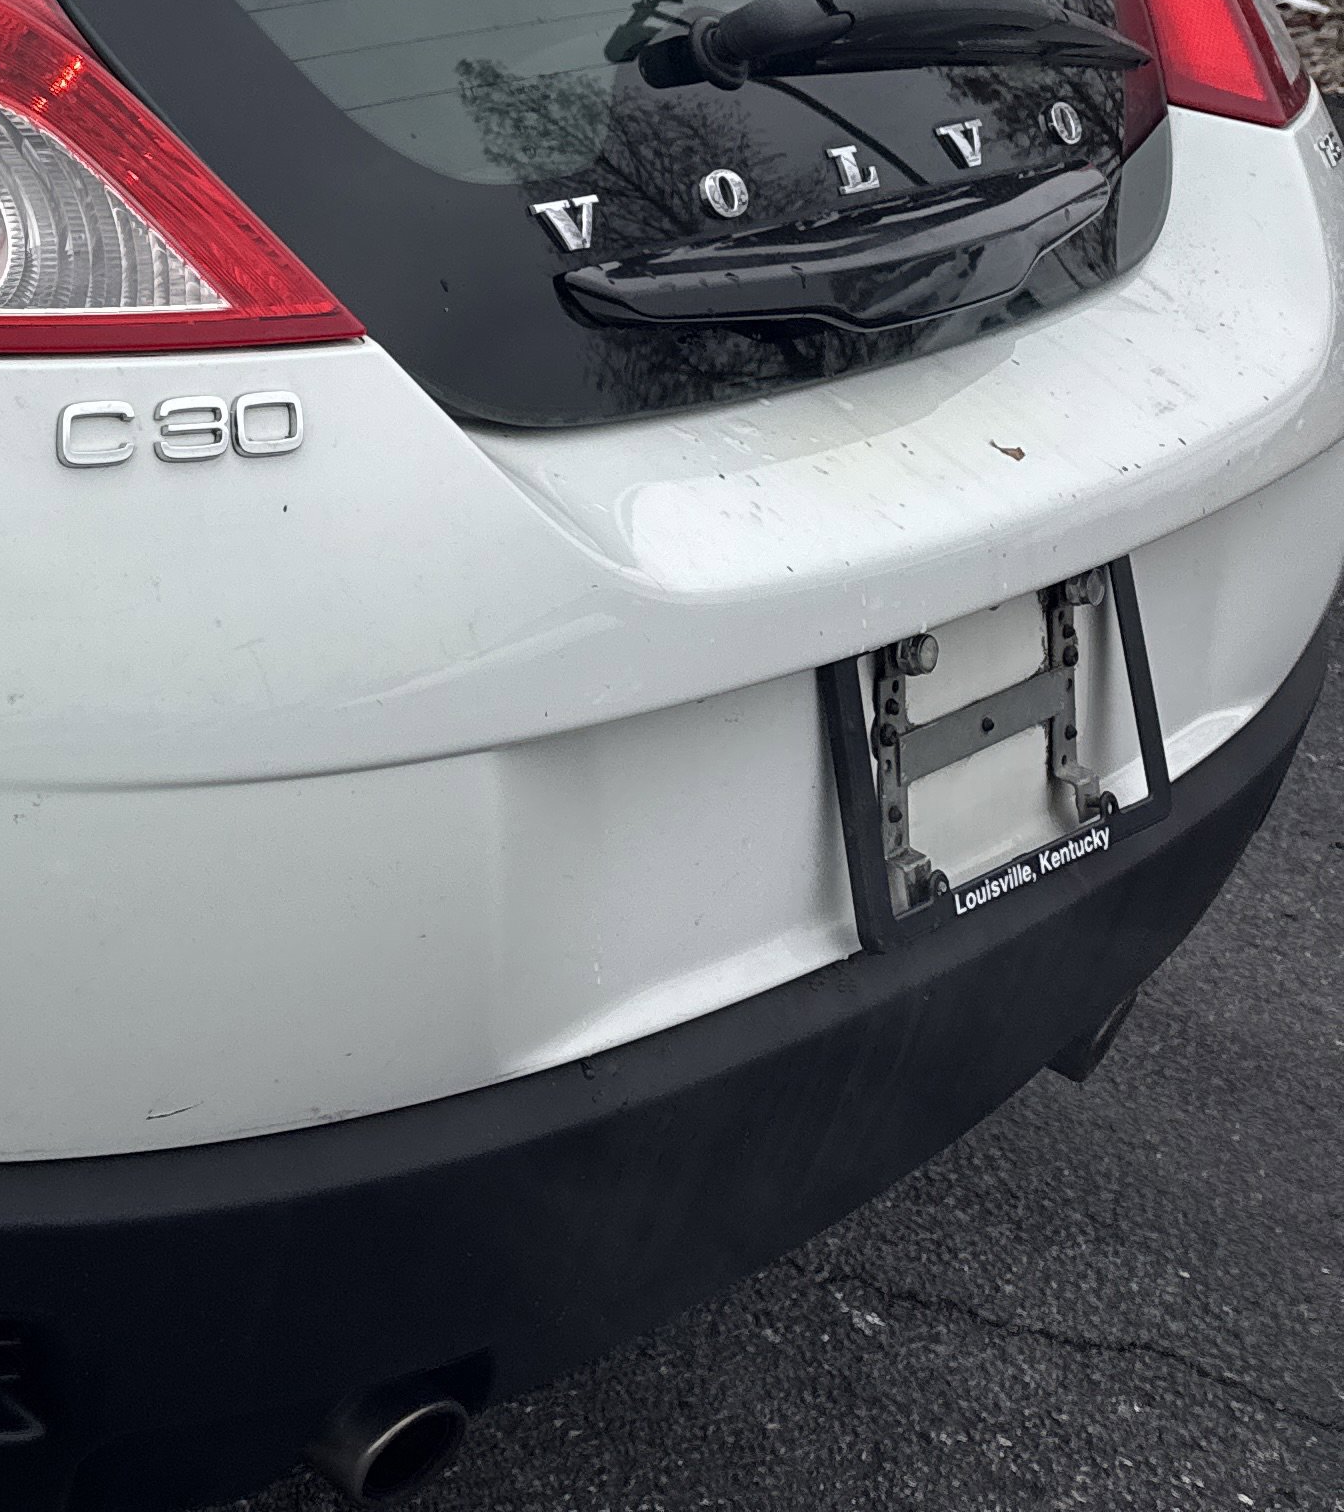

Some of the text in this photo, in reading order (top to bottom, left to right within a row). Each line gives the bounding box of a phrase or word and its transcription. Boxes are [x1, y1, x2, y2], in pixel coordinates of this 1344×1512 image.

[529, 100, 1084, 252] VOLVO
[55, 389, 305, 469] C30
[954, 826, 1111, 916] Louisville, Kentucky
